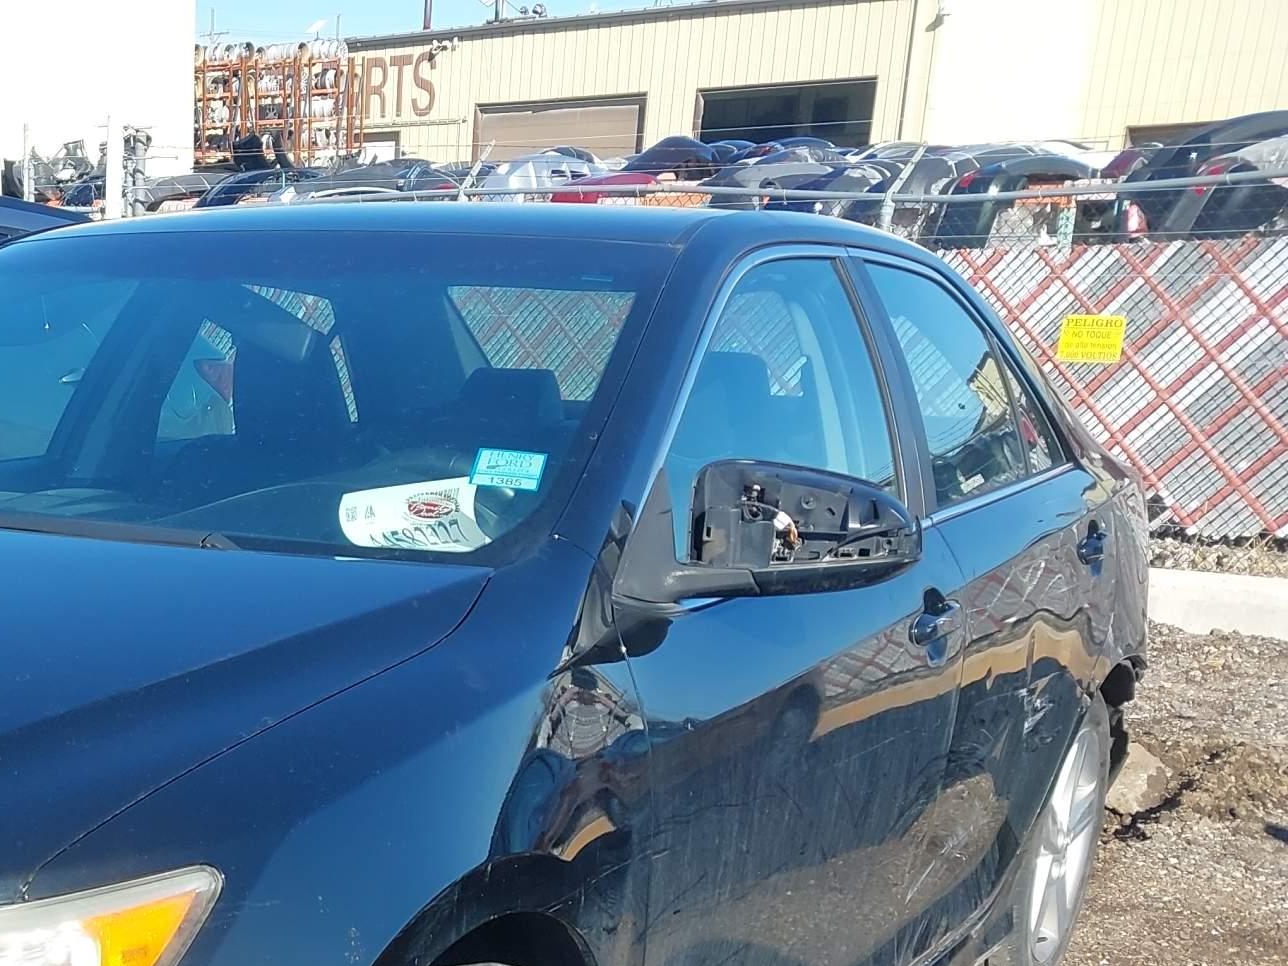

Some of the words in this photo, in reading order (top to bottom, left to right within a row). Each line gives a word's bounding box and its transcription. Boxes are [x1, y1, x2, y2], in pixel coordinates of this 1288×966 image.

[1066, 318, 1123, 328] PELIGRO
[1072, 330, 1084, 339] NO
[1086, 330, 1112, 339] TOQUE
[488, 476, 522, 487] 1385
